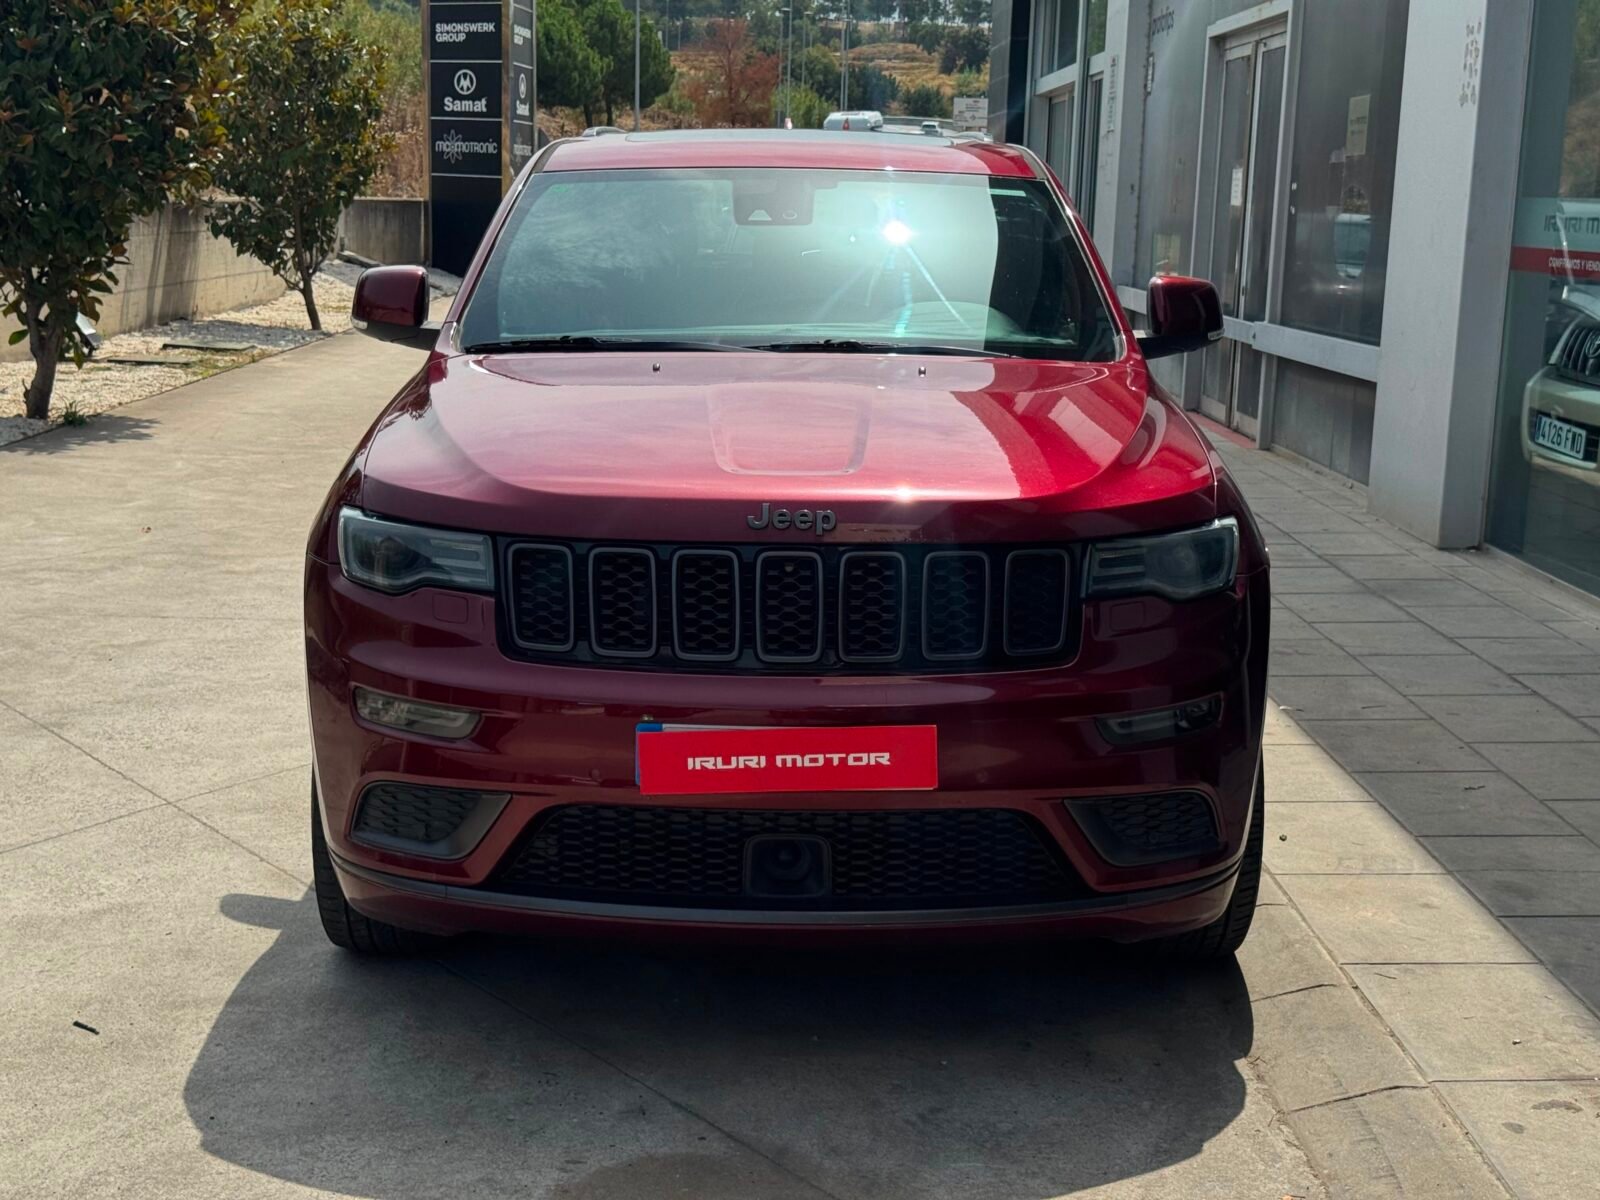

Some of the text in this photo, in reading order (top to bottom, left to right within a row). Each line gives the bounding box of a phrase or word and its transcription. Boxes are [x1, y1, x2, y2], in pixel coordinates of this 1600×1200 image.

[435, 22, 496, 33] SIMONSWERK
[435, 33, 467, 43] GROUP
[443, 96, 488, 113] Samat
[747, 502, 837, 536] Jeep
[687, 752, 891, 770] IRURI MOTOR
